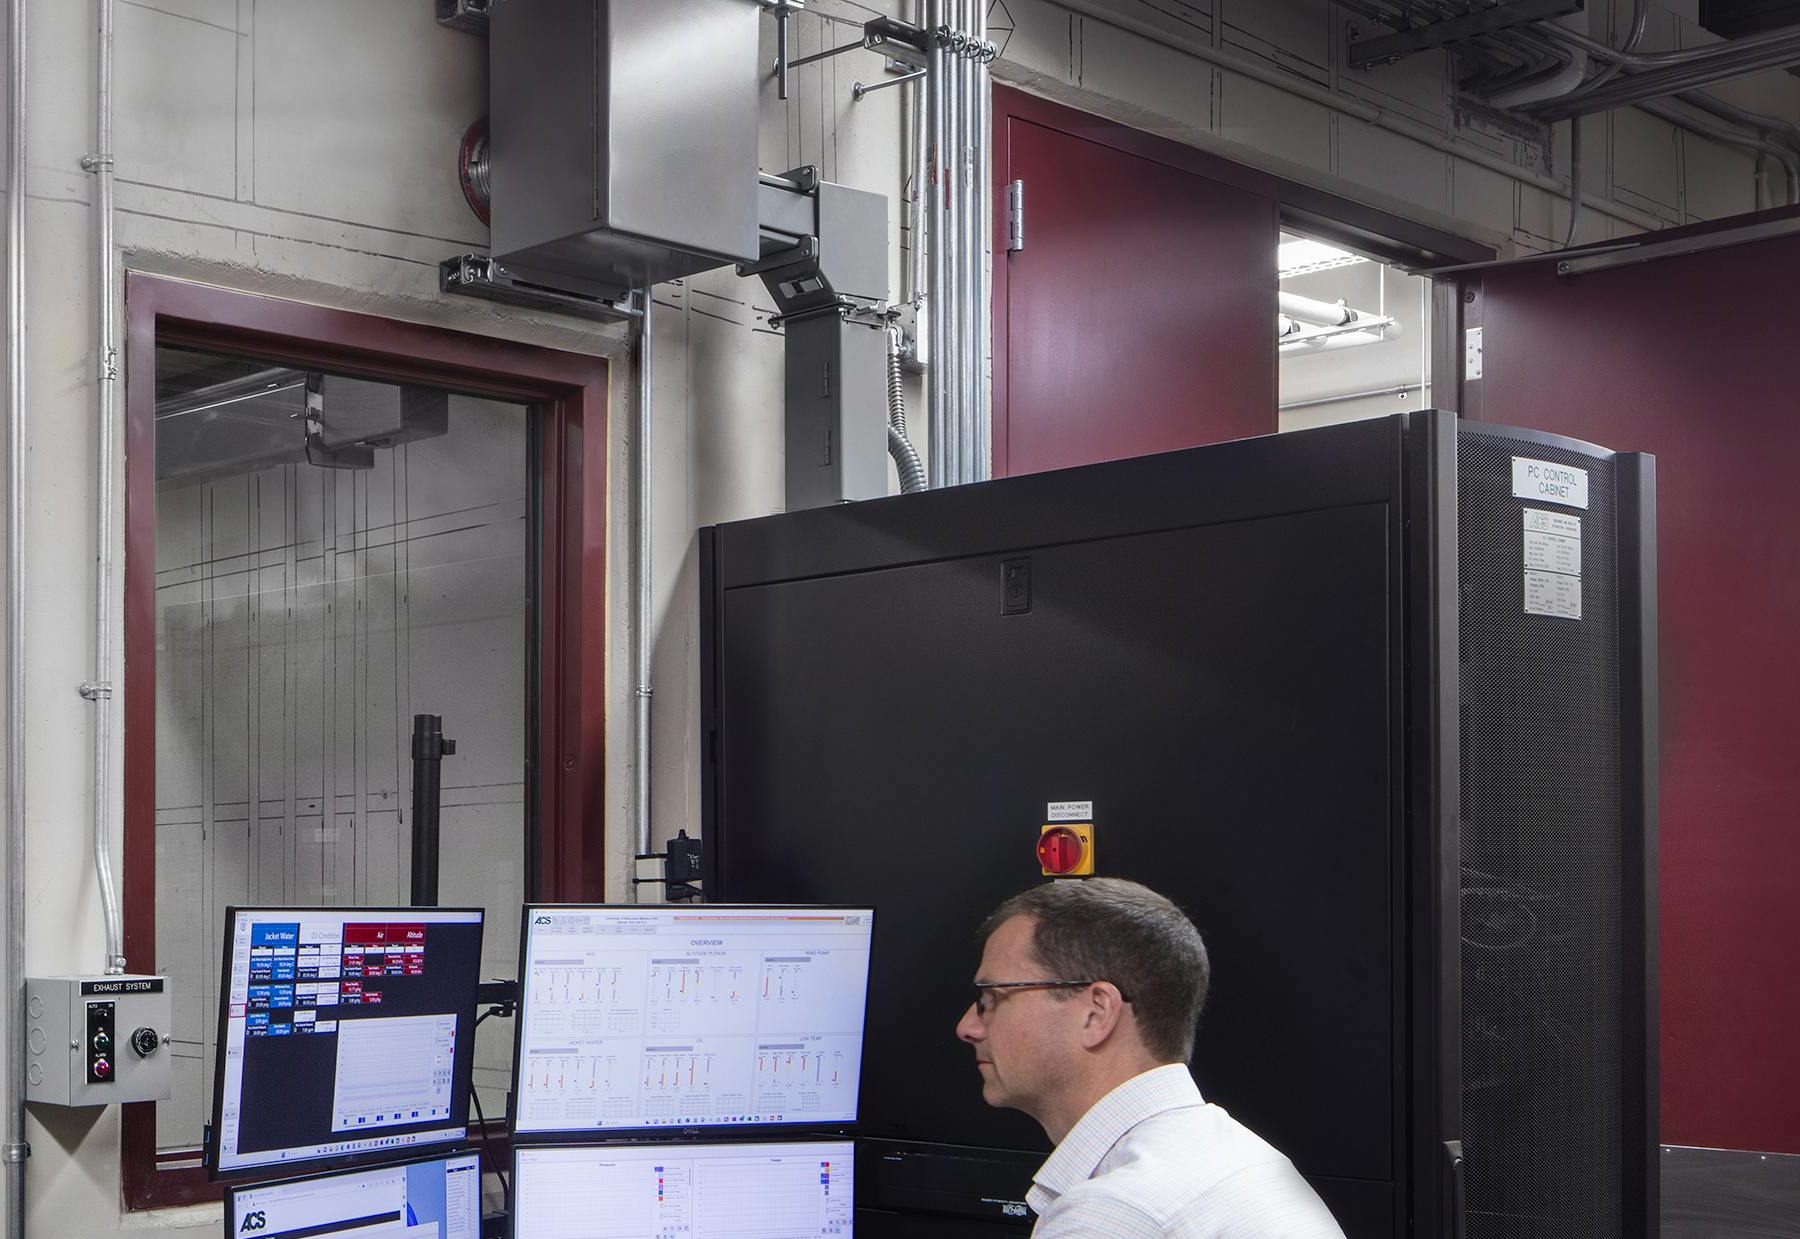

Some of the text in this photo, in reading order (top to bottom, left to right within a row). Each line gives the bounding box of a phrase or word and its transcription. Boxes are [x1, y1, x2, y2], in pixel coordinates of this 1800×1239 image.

[1528, 466, 1577, 486] PC CONTROL
[1538, 482, 1569, 498] CABINET
[535, 916, 552, 925] ACS
[265, 932, 295, 941] Jacket Water
[376, 930, 385, 939] Air
[406, 930, 424, 939] Altitude
[93, 982, 152, 992] EXHAUST SYSTEM
[240, 1210, 266, 1233] ACS
